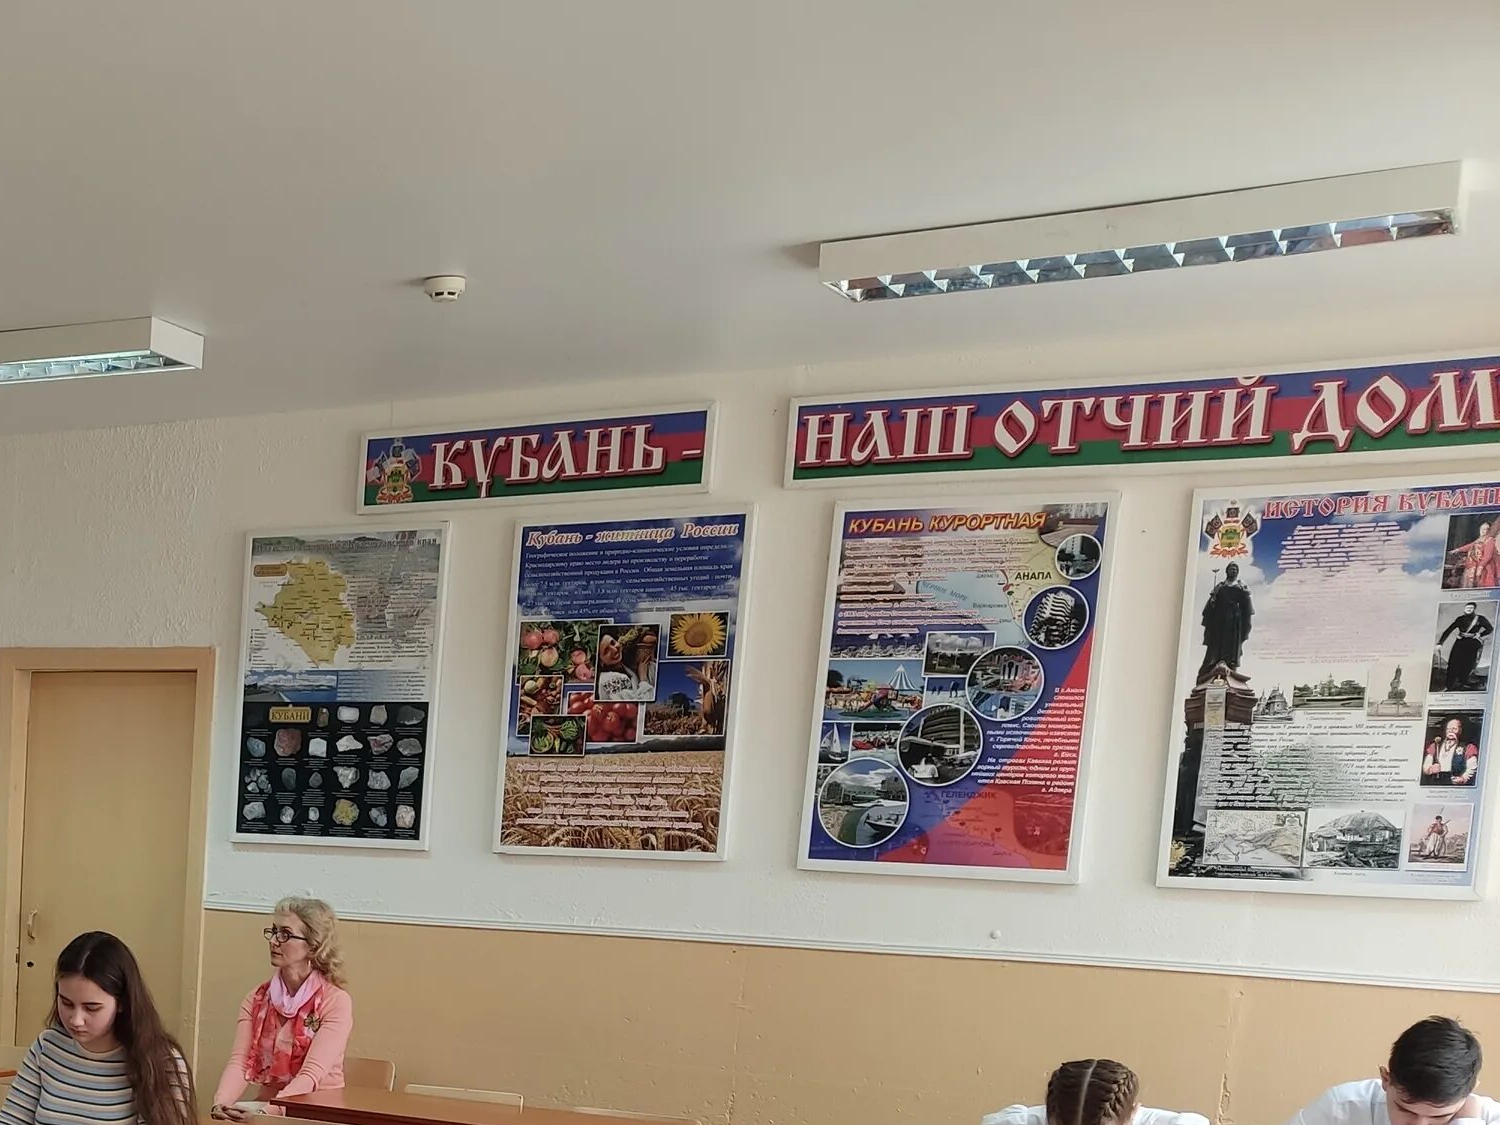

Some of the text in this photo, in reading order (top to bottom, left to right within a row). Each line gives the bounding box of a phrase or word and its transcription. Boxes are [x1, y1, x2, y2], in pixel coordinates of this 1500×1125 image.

[798, 365, 1500, 468] НАШ ОТЧИЙ ДОМ
[429, 423, 668, 498] КУБАНЬ
[1262, 493, 1391, 520] ИСТОРИЯ
[526, 529, 584, 549] Кубань
[595, 526, 676, 544] житница
[680, 522, 740, 539] России
[848, 512, 1049, 534] КУБАНЬ КУРОРТНАЯ
[1014, 571, 1053, 581] АНАПА
[271, 710, 311, 722] КУБАНИ
